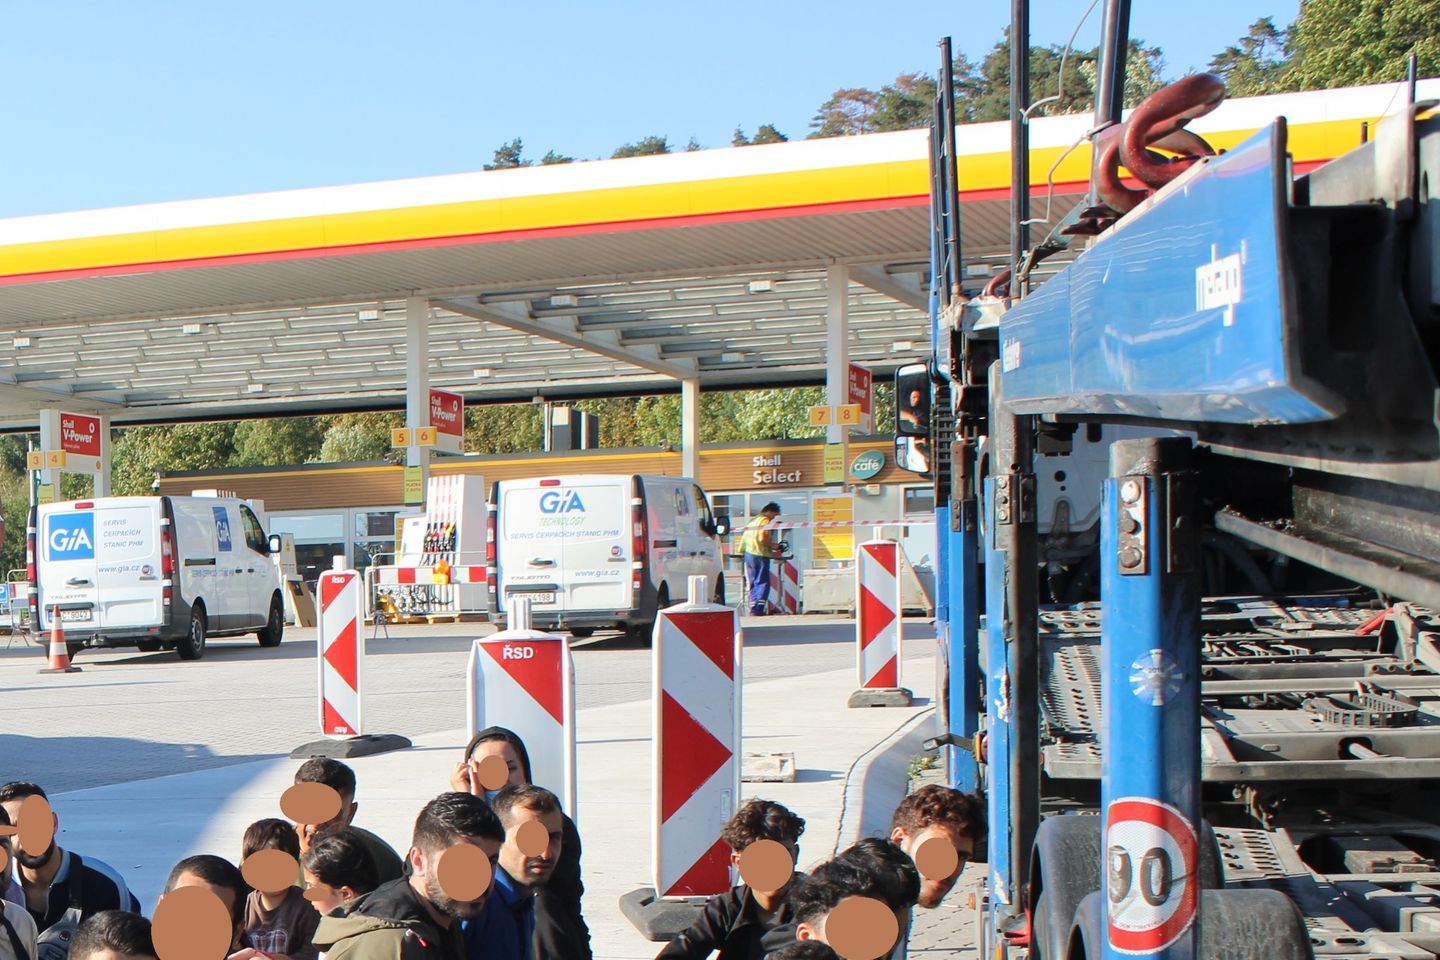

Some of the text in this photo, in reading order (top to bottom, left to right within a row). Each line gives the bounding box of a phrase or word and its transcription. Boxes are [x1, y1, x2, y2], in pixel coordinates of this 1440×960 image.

[817, 411, 825, 421] 7
[843, 409, 851, 420] 8
[63, 429, 93, 444] V-Power
[398, 433, 405, 443] 5
[420, 431, 428, 441] 6
[51, 454, 58, 464] 4
[752, 455, 781, 467] Shell
[752, 469, 802, 484] Select
[98, 565, 141, 573] www.gia.cz
[574, 569, 620, 577] www.gia.cz
[502, 644, 534, 660] ŘSD
